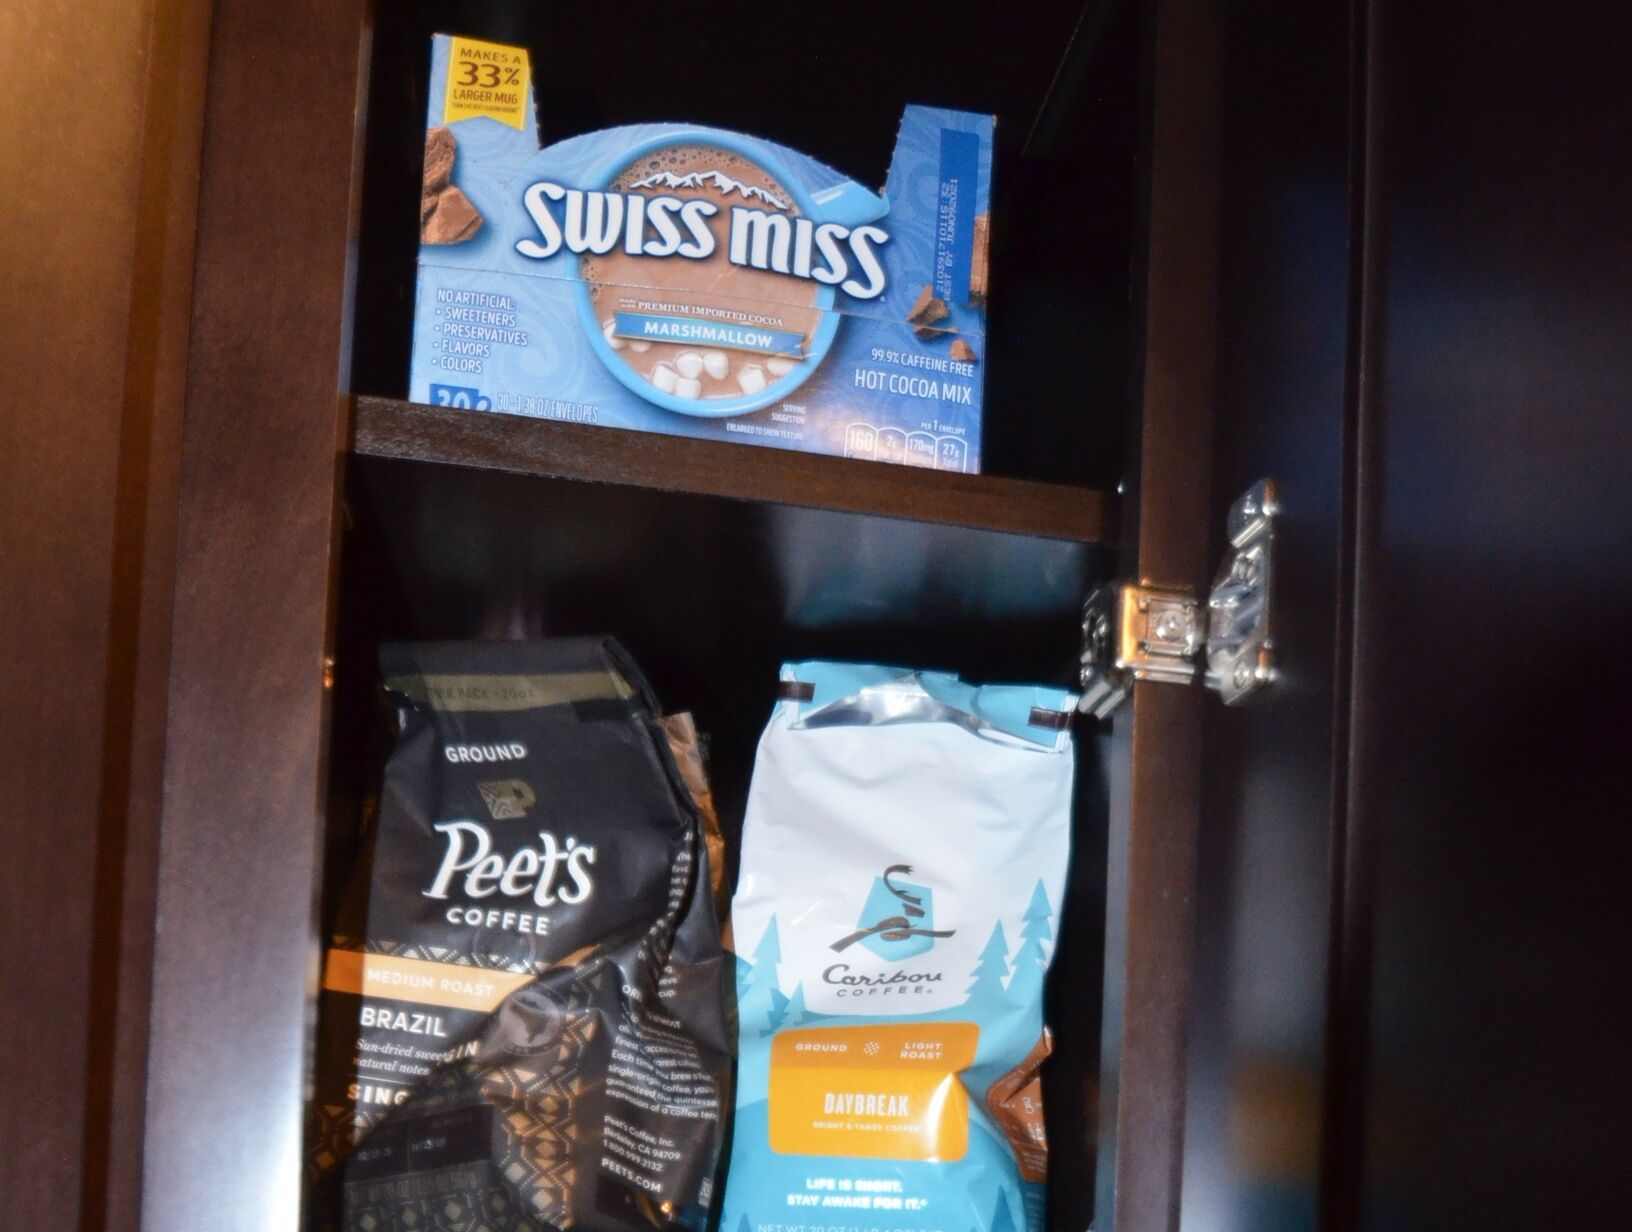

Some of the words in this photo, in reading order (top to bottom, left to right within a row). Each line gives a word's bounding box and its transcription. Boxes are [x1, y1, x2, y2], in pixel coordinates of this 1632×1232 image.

[460, 47, 509, 63] MAKES
[512, 56, 521, 65] A
[456, 61, 520, 89] 33%
[453, 89, 493, 102] LARGER
[494, 93, 518, 105] MUG
[516, 182, 719, 259] SWISS
[730, 206, 889, 299] MISS
[945, 253, 953, 267] BY
[437, 289, 453, 302] NO
[456, 291, 515, 310] ARTIFICIAL:
[445, 306, 516, 327] SWEETENERS
[638, 301, 689, 314] PREMIUM
[692, 306, 747, 322] IMPORTED
[748, 314, 784, 327] COCOA
[443, 323, 528, 346] PRESERVATIVES
[644, 321, 773, 349] MARSHMALLOW
[442, 339, 490, 358] FLAVORS
[440, 356, 482, 374] COLORS
[871, 348, 900, 364] 99.9%
[900, 353, 948, 373] CAFFEINE
[949, 362, 974, 378] FREE
[854, 368, 888, 391] HOT
[888, 374, 939, 400] COCOA
[942, 383, 972, 406] MIX
[537, 400, 549, 416] OZ
[550, 401, 599, 423] ENVELOPES
[849, 430, 874, 452] 160
[445, 743, 528, 763] GROUND
[422, 821, 595, 907] Peet's
[446, 906, 550, 936] COFFEE
[367, 969, 435, 989] MEDIUM
[440, 978, 495, 997] ROAST
[822, 963, 943, 986] Caribou
[836, 985, 924, 998] COFFEE
[359, 1006, 447, 1038] BRAZIL
[356, 1038, 415, 1058] Sun-dried
[611, 1049, 634, 1063] Each
[795, 1042, 848, 1053] GROUND
[904, 1041, 943, 1051] LIGHT
[899, 1051, 943, 1060] ROAST
[353, 1057, 396, 1073] natural
[398, 1064, 430, 1076] notes
[607, 1064, 661, 1087] single-origin
[605, 1089, 649, 1109] expression
[824, 1092, 910, 1117] DAYBREAK
[637, 1144, 651, 1155] CA
[601, 1157, 662, 1193] PEETS.COM
[805, 1177, 836, 1191] LIFE
[838, 1178, 852, 1192] IS
[854, 1179, 904, 1193] SHORT.
[786, 1194, 819, 1207] STAY
[821, 1195, 871, 1210] AWAKE
[872, 1196, 901, 1210] FOR
